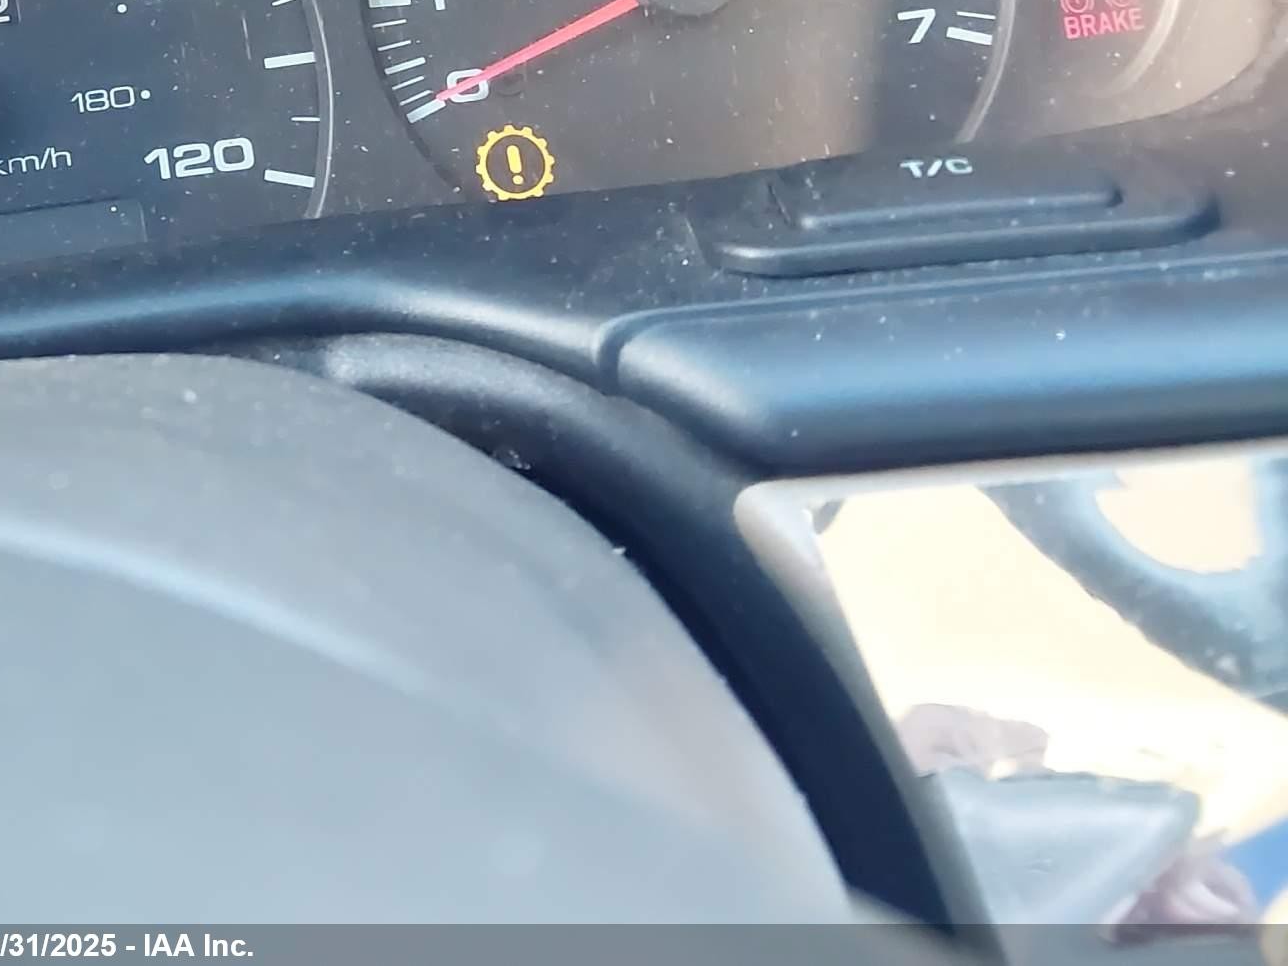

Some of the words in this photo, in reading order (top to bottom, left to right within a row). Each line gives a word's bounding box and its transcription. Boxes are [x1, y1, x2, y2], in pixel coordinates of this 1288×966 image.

[897, 8, 936, 44] 7
[1064, 8, 1145, 40] BRAKE
[71, 86, 135, 113] 180
[446, 69, 489, 103] 0
[143, 137, 255, 180] 120
[899, 156, 974, 178] T/C
